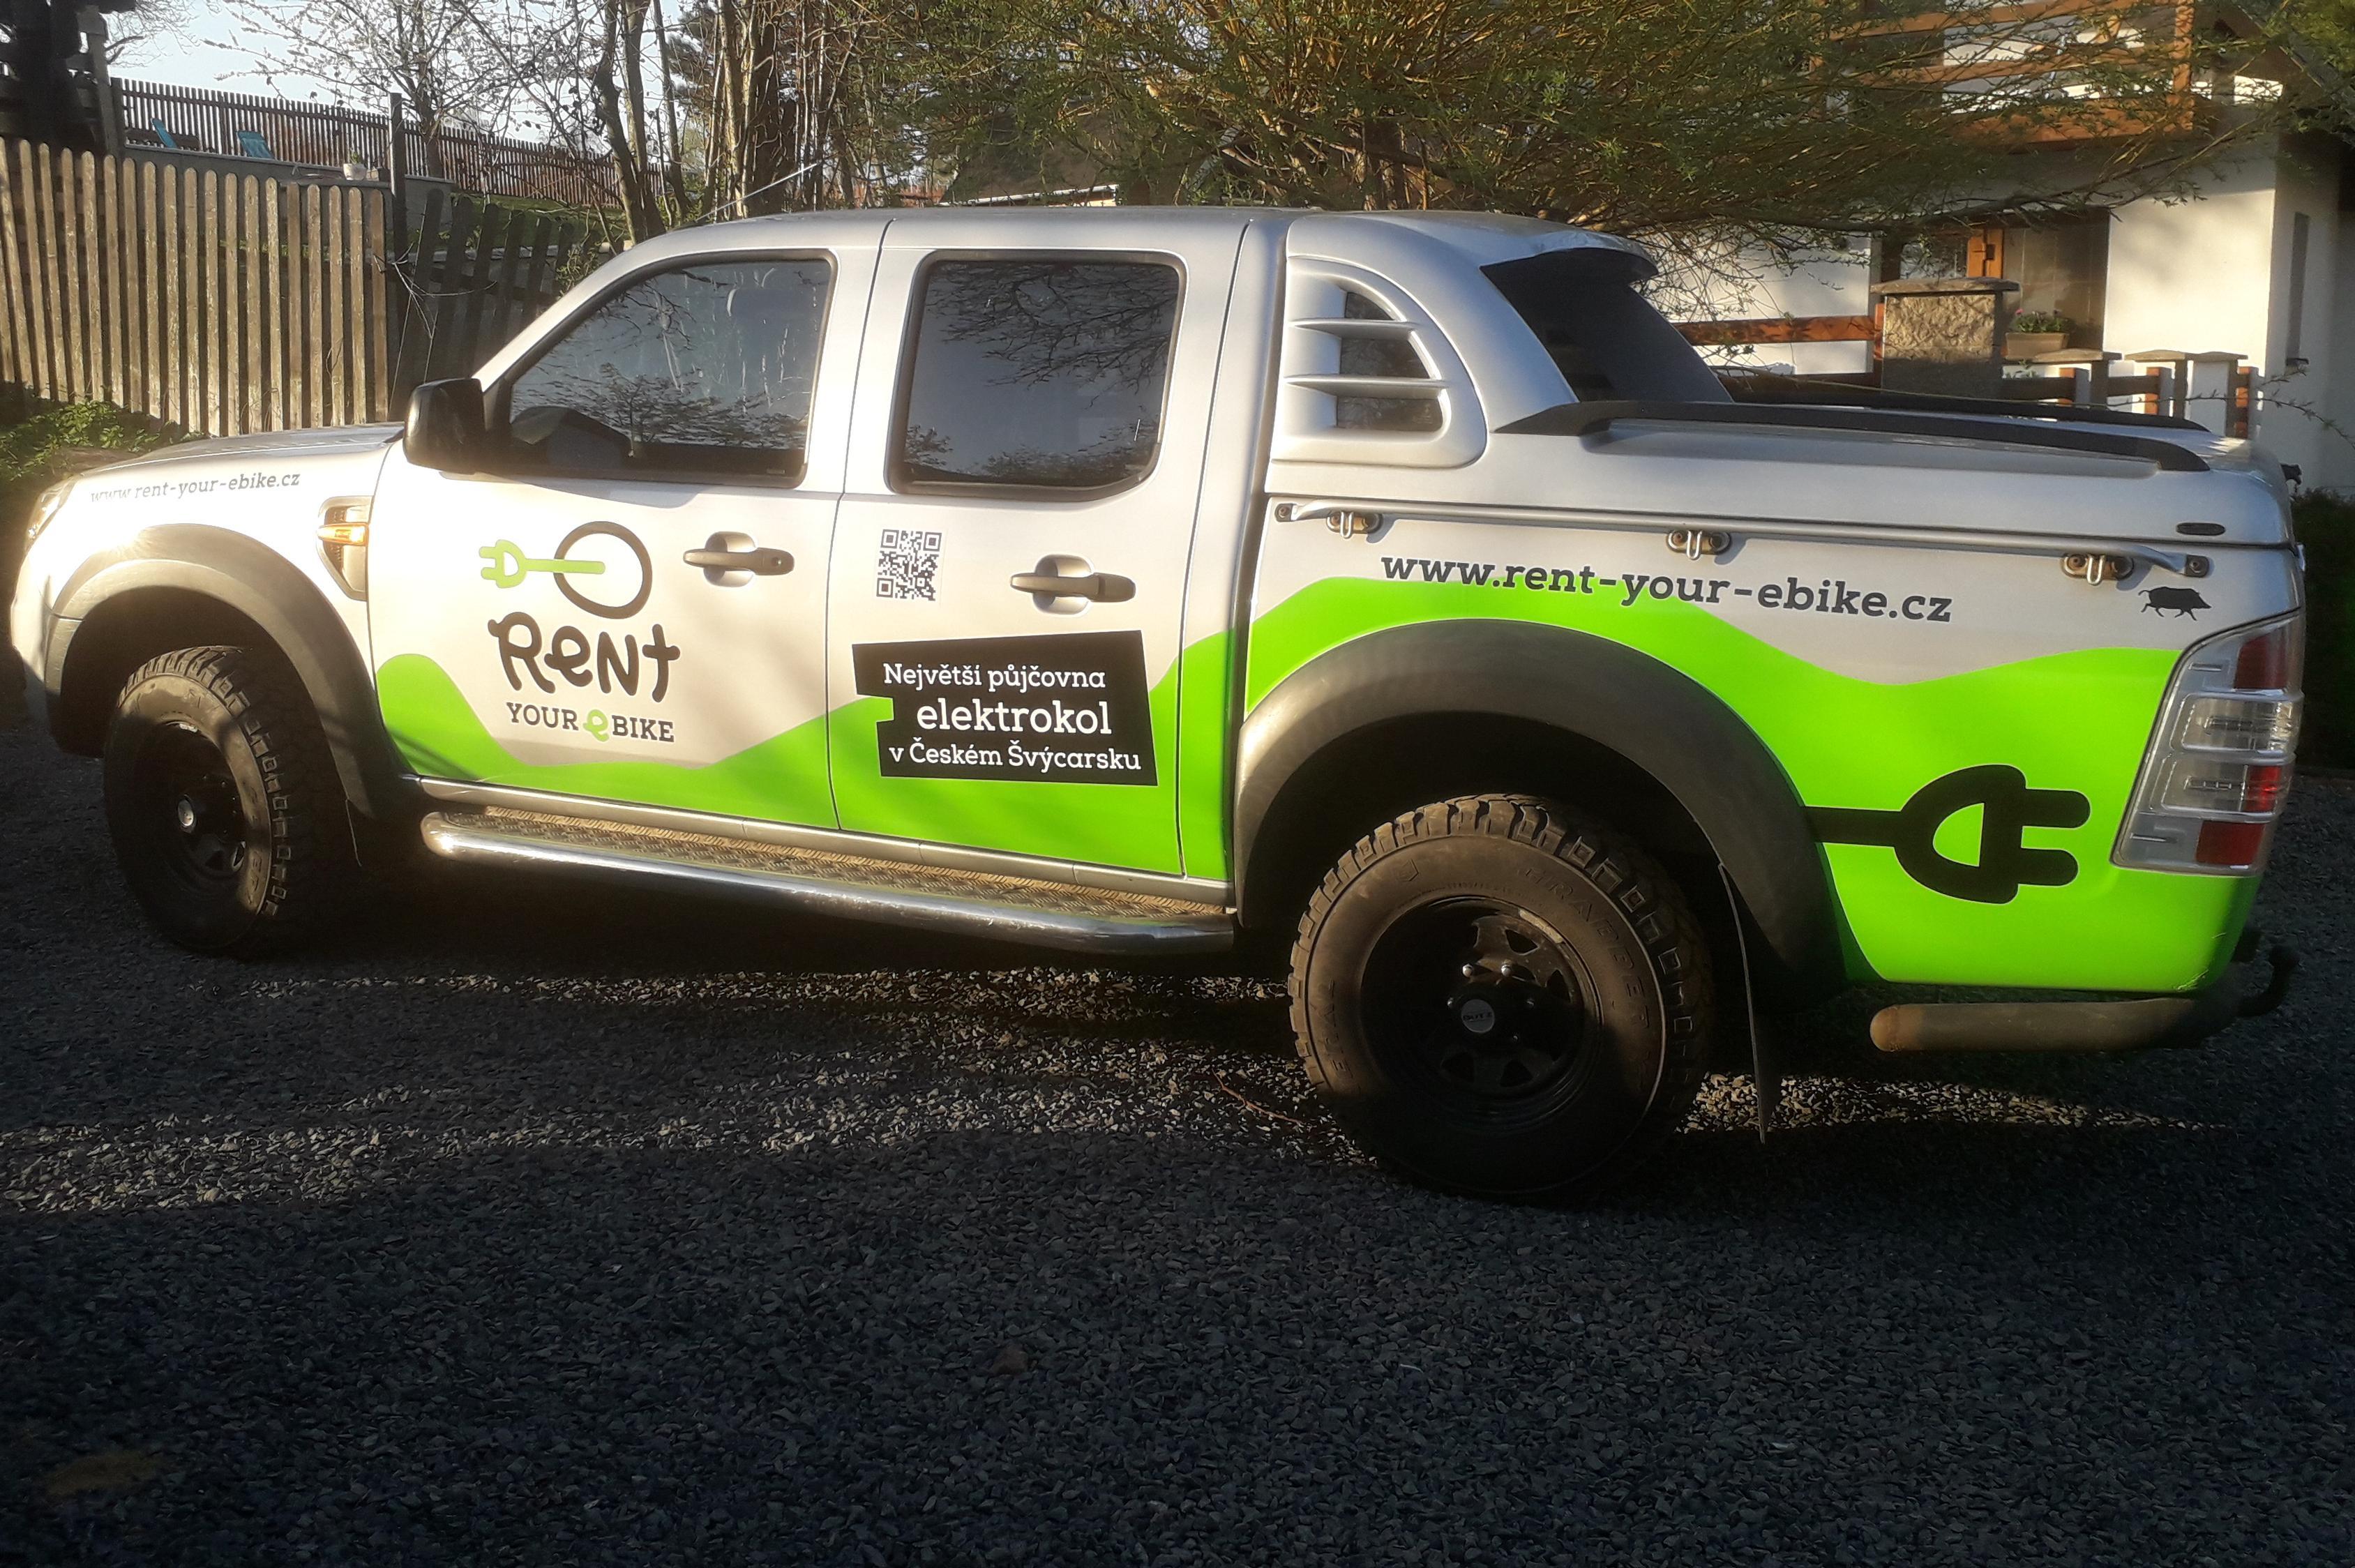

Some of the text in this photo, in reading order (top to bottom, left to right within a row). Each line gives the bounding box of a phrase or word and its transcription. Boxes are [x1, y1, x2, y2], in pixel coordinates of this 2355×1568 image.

[1381, 557, 1952, 622] www.rent-your-ebike.cz
[883, 663, 1106, 693] Největší půjčovna
[506, 702, 579, 730] YOUR
[917, 698, 1112, 734] elektrokol
[889, 737, 1142, 773] v Českém Švýcarsku
